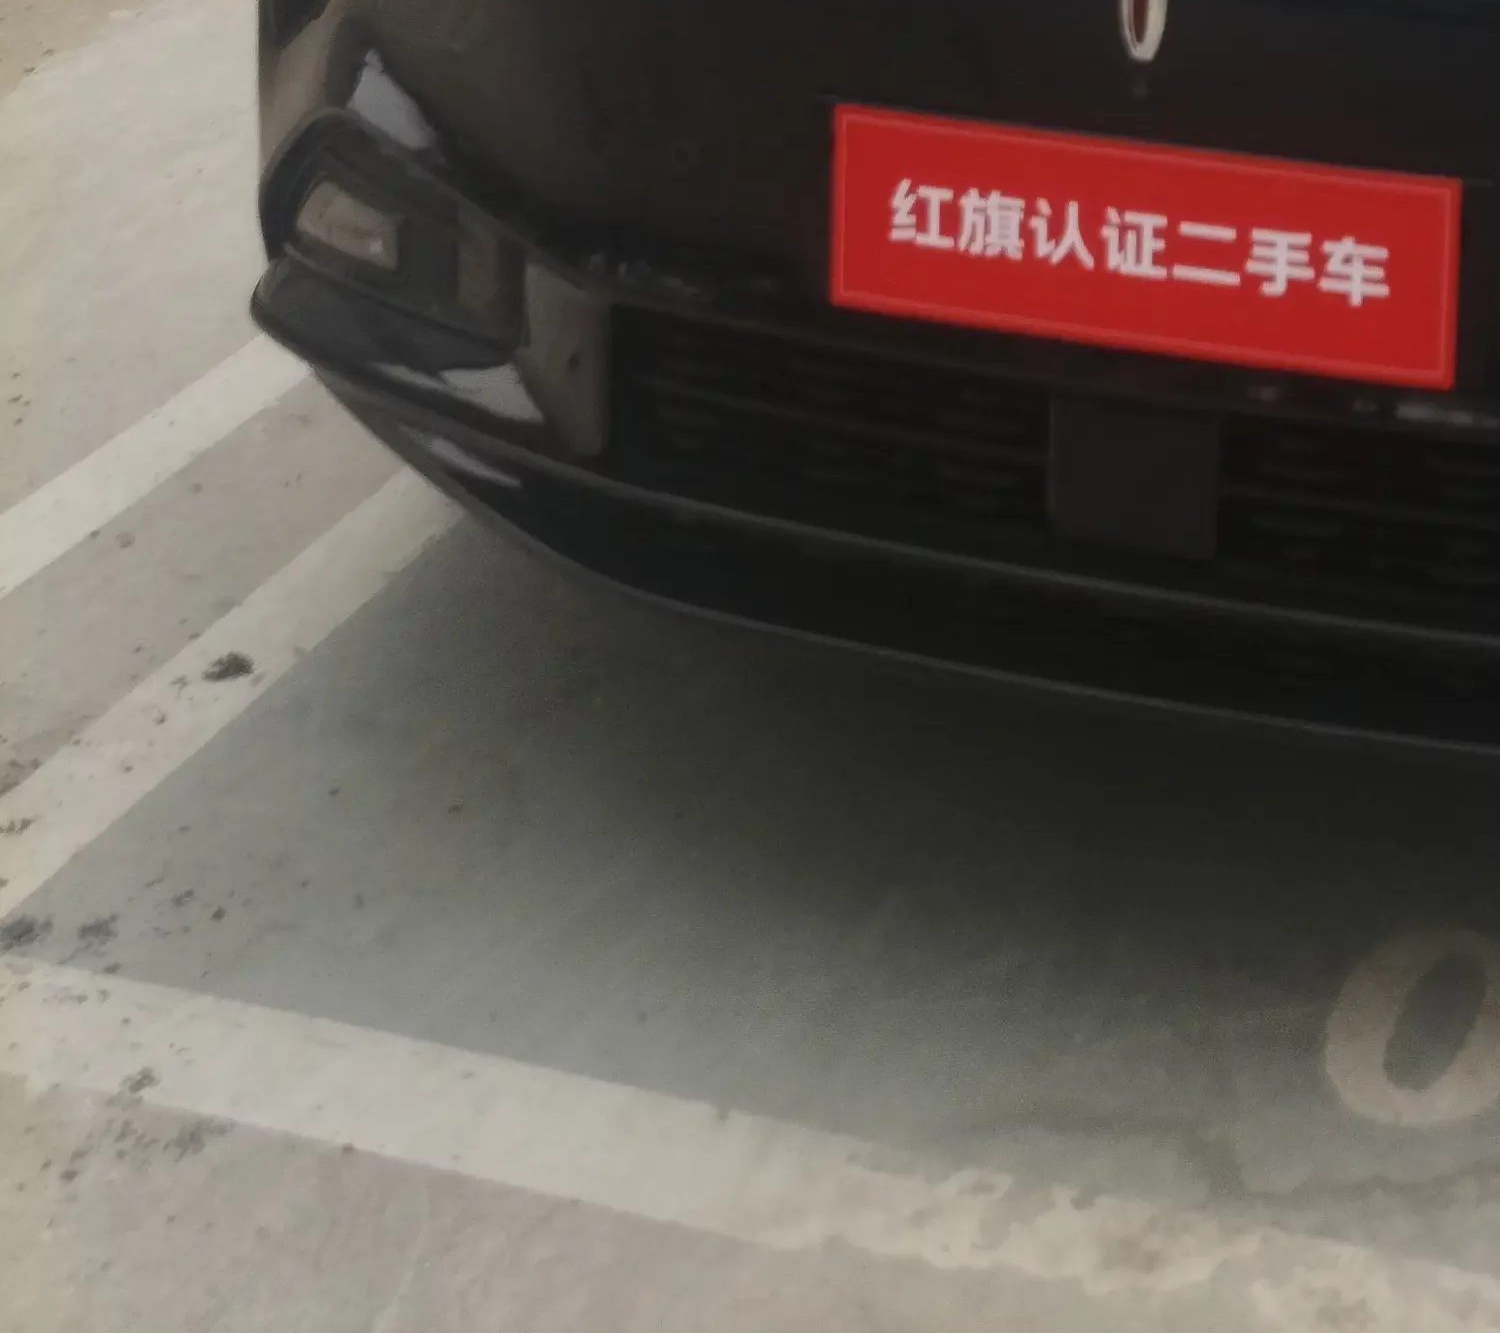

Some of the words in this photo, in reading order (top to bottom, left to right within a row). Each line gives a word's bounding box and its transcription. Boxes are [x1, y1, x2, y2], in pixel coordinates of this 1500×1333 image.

[888, 178, 1391, 307] 红旗认证二手车
